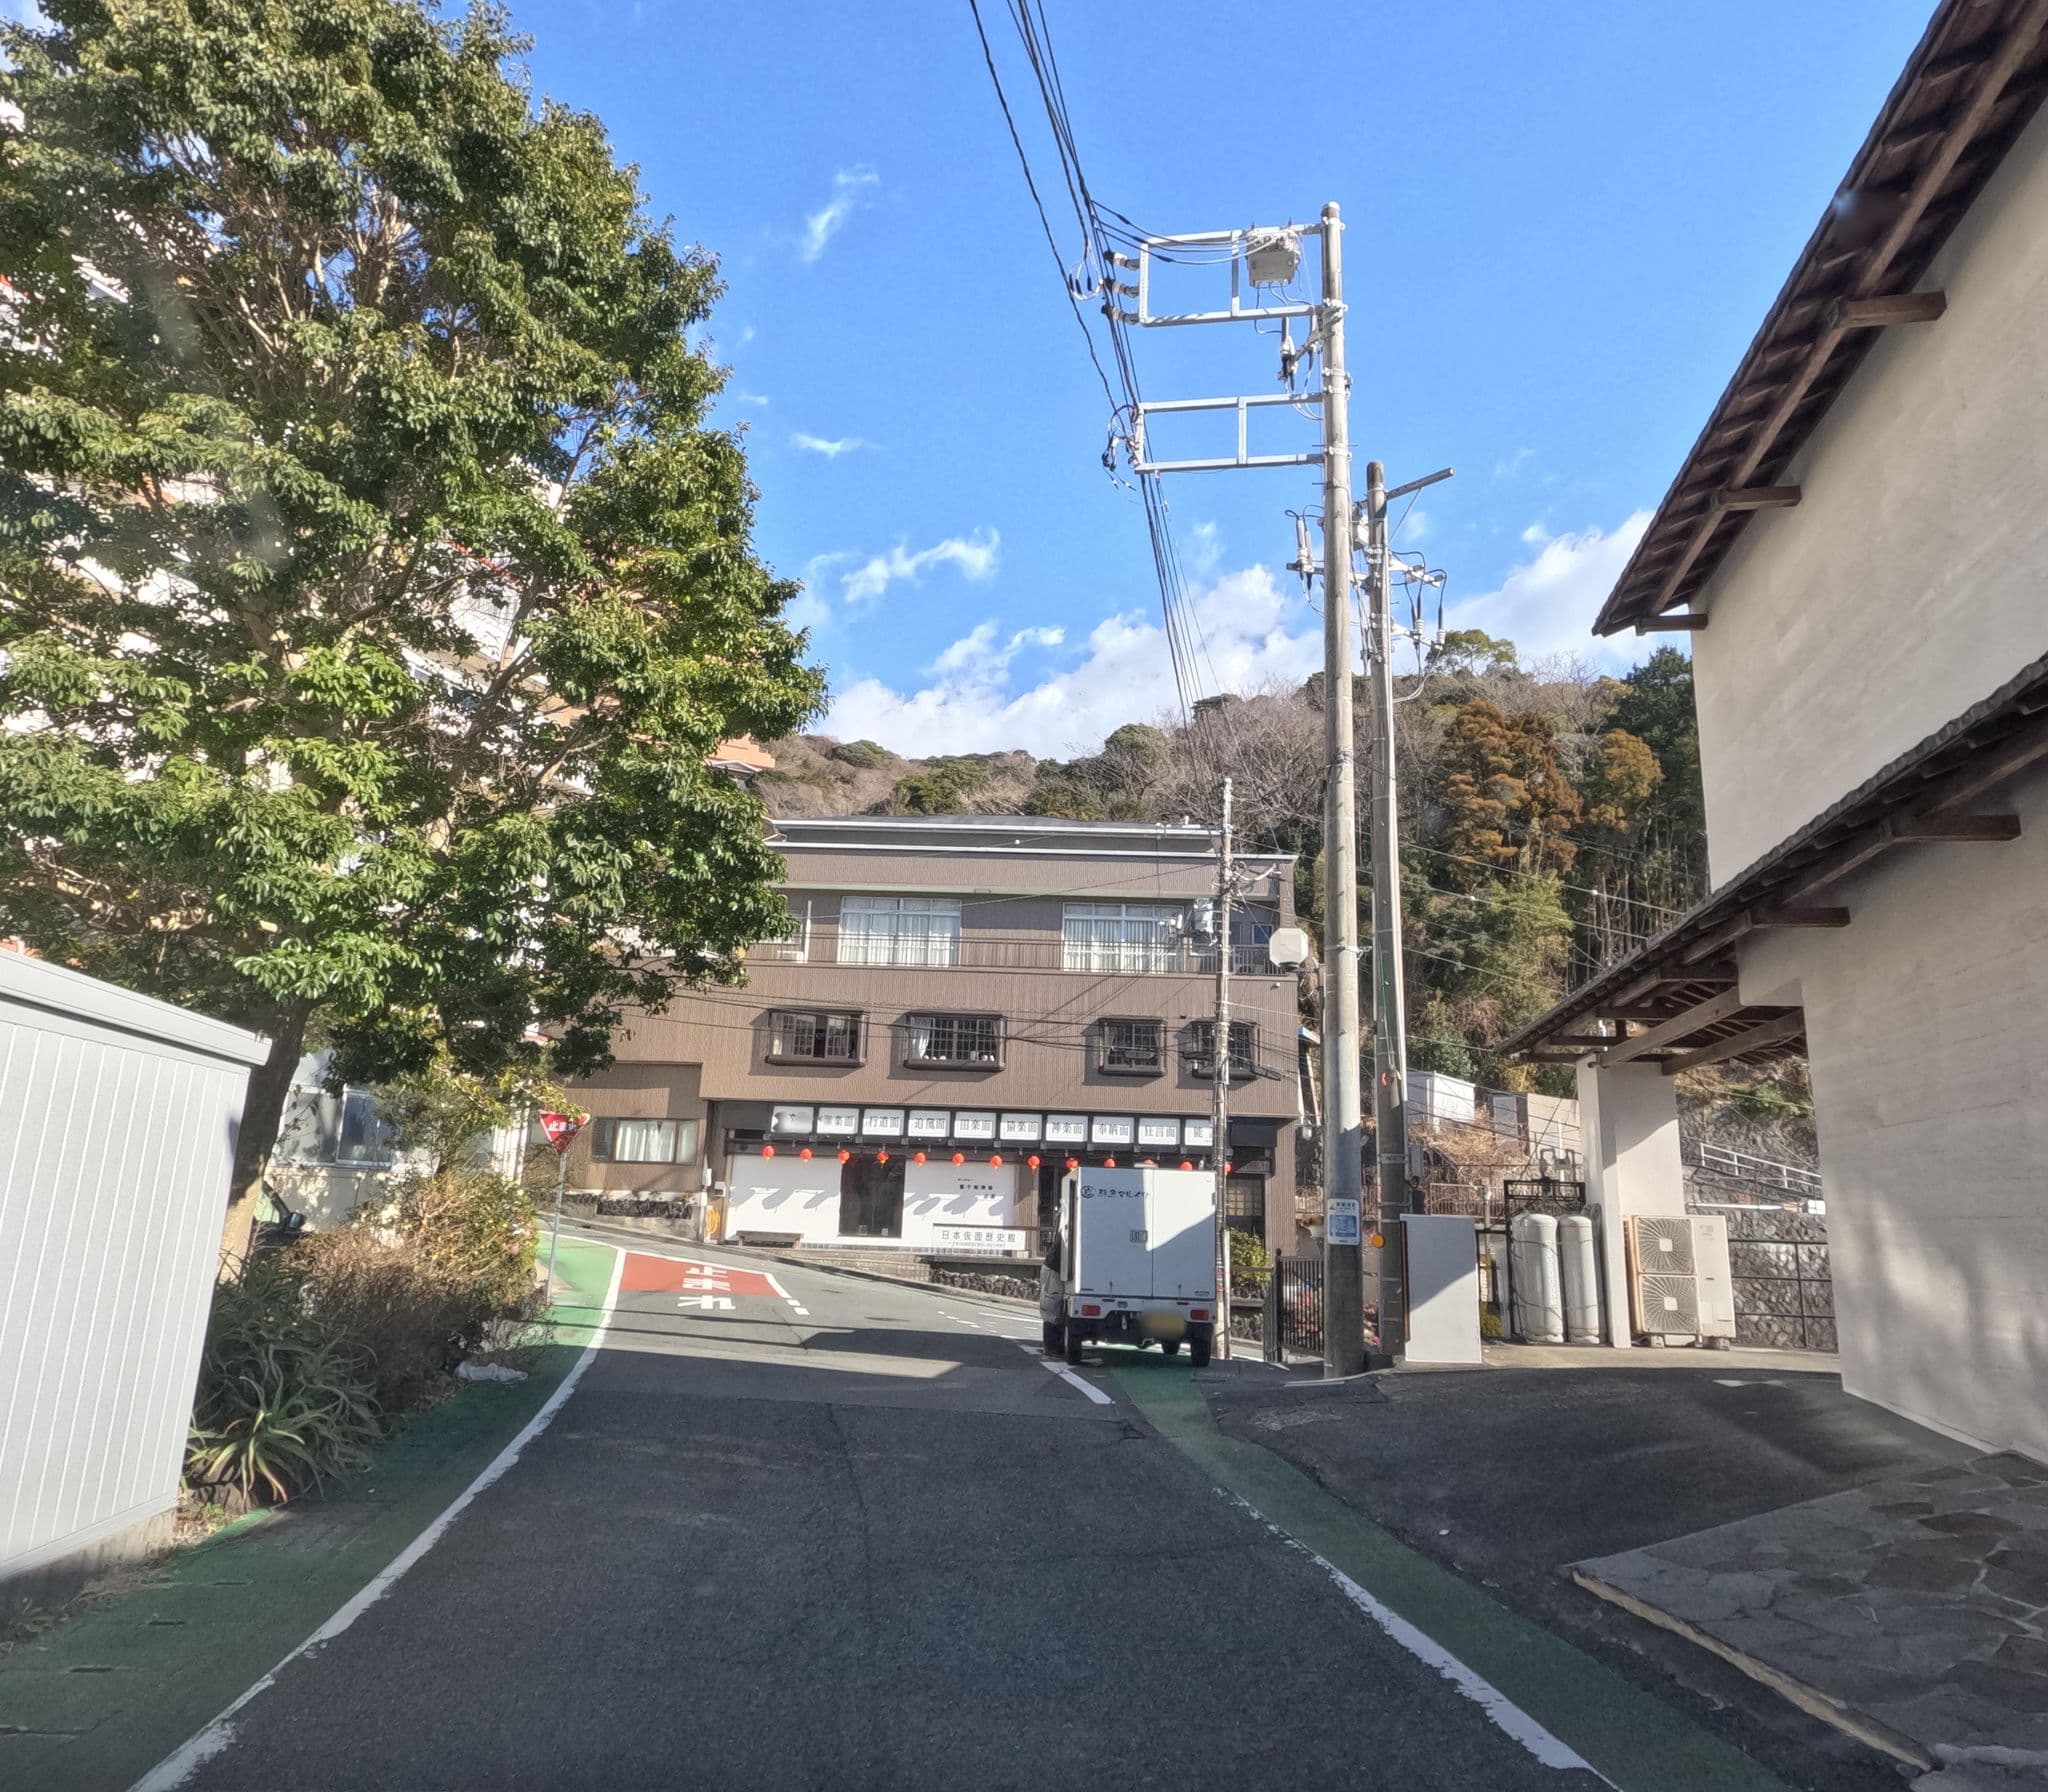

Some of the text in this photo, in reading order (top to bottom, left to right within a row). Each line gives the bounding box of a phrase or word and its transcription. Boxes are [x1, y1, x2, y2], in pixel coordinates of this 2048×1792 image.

[942, 1230, 1016, 1243] 日本仮面歴史館
